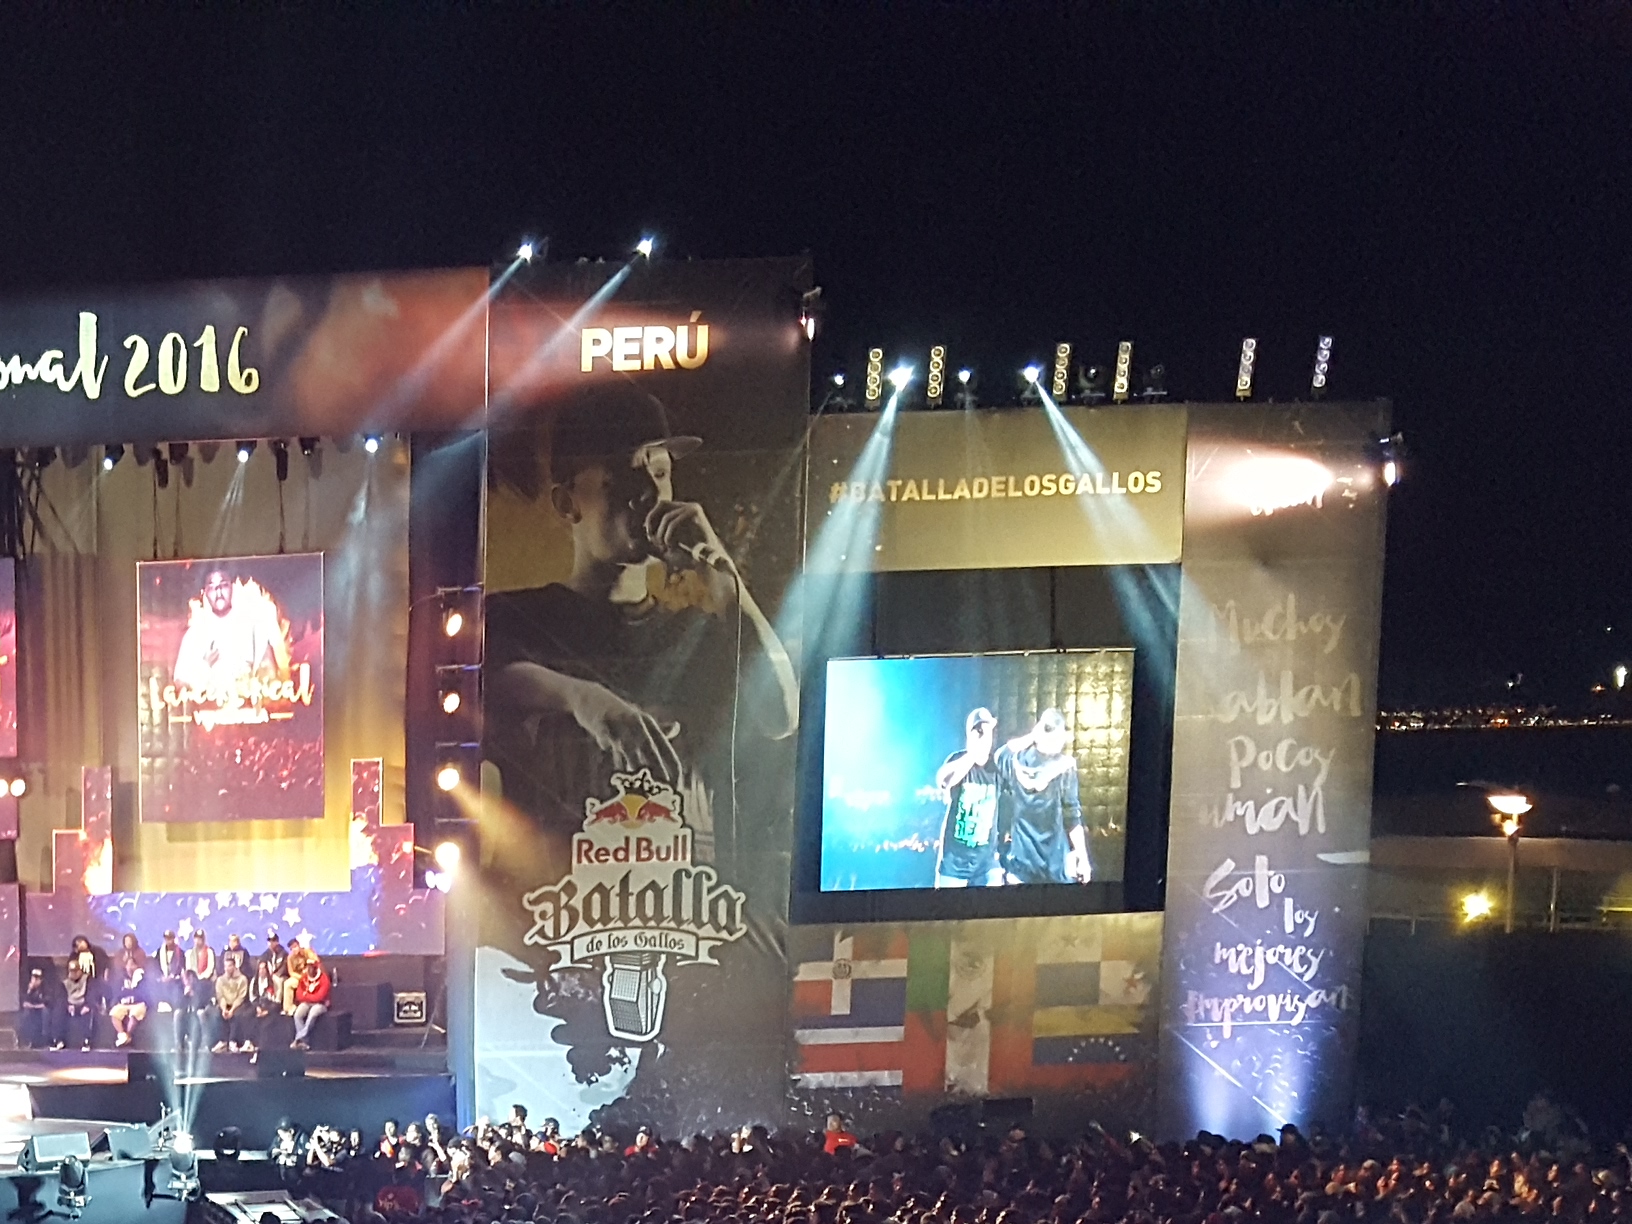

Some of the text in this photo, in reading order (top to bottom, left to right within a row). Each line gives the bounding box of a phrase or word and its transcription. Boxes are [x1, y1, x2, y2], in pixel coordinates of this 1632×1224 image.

[123, 324, 260, 398] 2016
[580, 310, 709, 373] PERÚ
[828, 470, 1163, 504] #BATALLADELOSGALLOS
[576, 834, 687, 864] Red Bull
[525, 867, 744, 942] Batalla
[1203, 855, 1286, 914] Solo
[586, 931, 685, 953] de los Gallos
[1284, 897, 1319, 937] los
[1214, 938, 1326, 990] mejores
